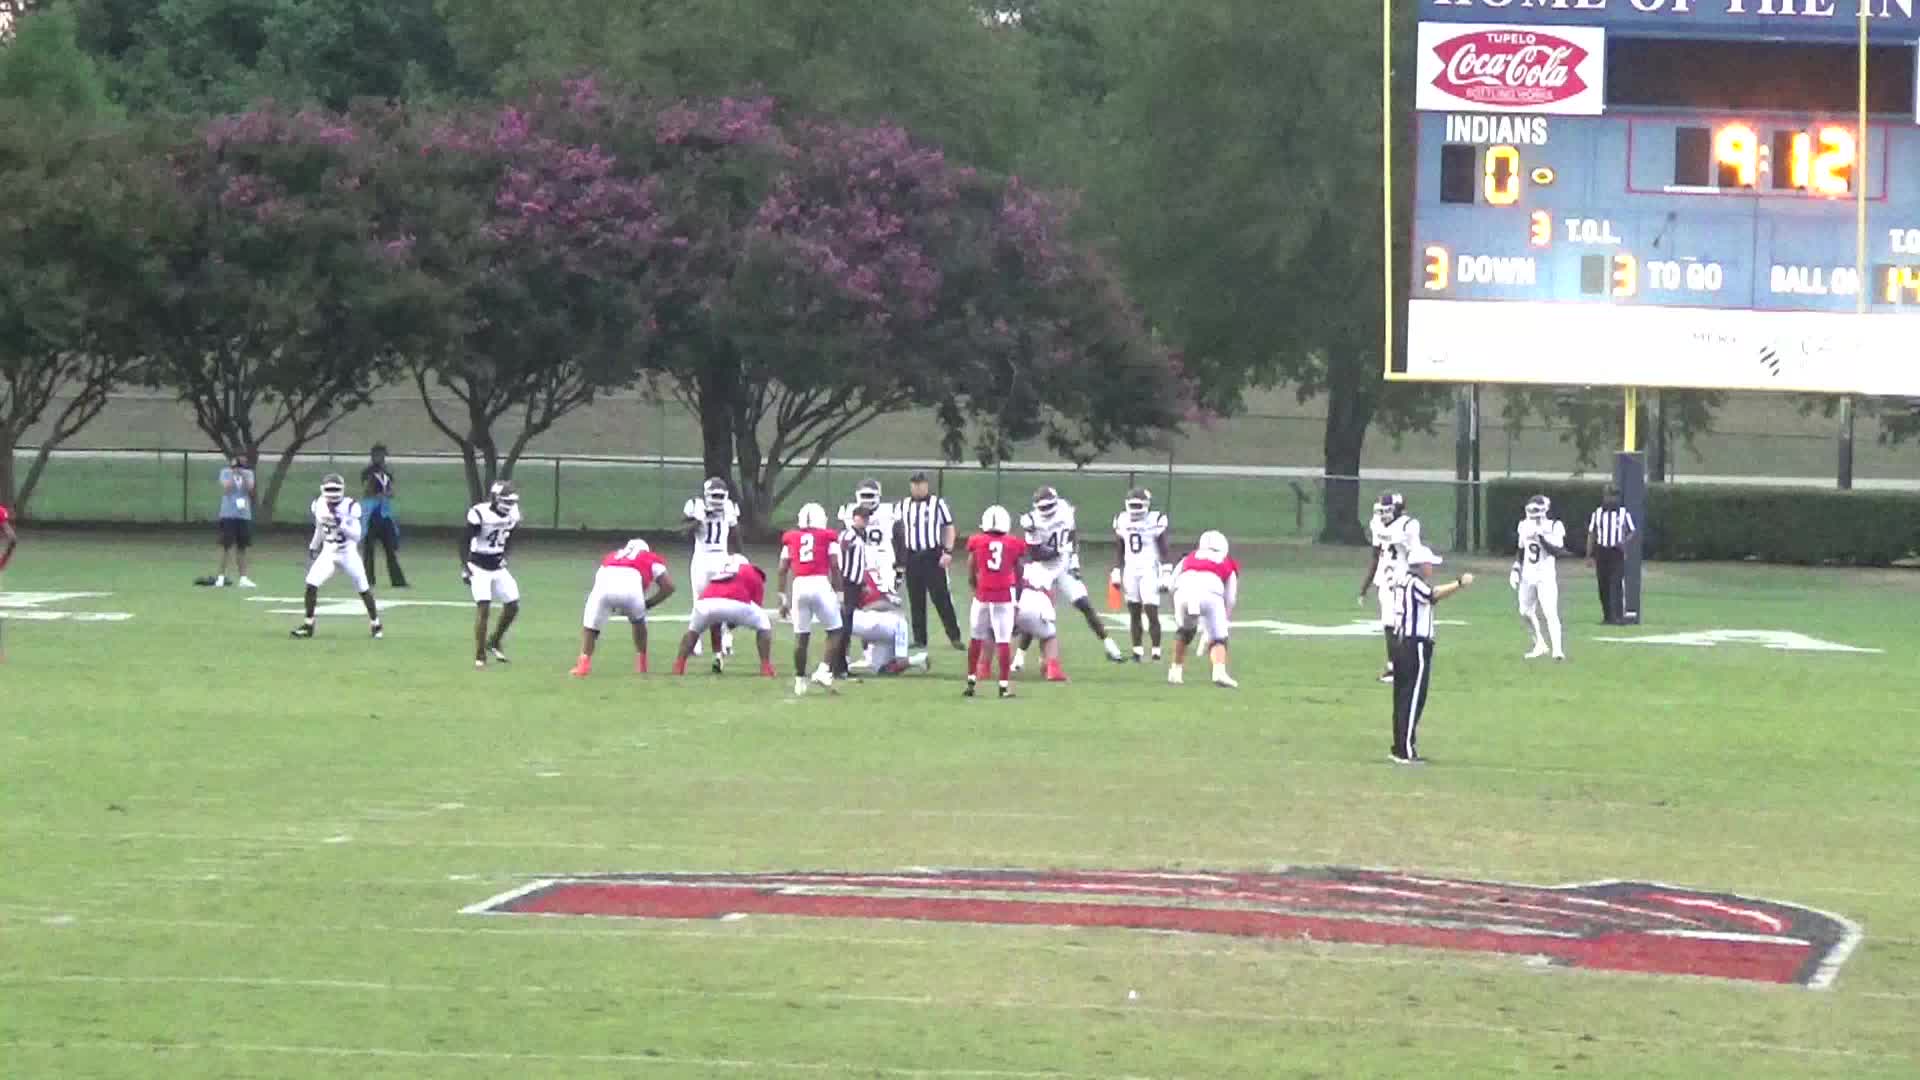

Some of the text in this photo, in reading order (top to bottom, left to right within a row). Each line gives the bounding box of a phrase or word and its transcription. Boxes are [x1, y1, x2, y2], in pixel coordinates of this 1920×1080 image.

[1486, 33, 1536, 44] TUPELO
[1447, 43, 1573, 87] Coca-Cola
[1446, 114, 1548, 145] INDIANS
[1714, 123, 1856, 196] 9:12
[1484, 146, 1520, 204] 0
[1531, 210, 1551, 246] 3
[1424, 246, 1449, 290] 3
[1457, 255, 1537, 285] DOWN
[1611, 254, 1637, 297] 3
[1647, 261, 1681, 289] TO
[1770, 265, 1827, 294] BALL
[704, 521, 722, 544] 11
[1129, 533, 1142, 554] 0
[799, 533, 815, 564] 2
[987, 541, 1003, 571] 3
[1528, 542, 1541, 564] 9
